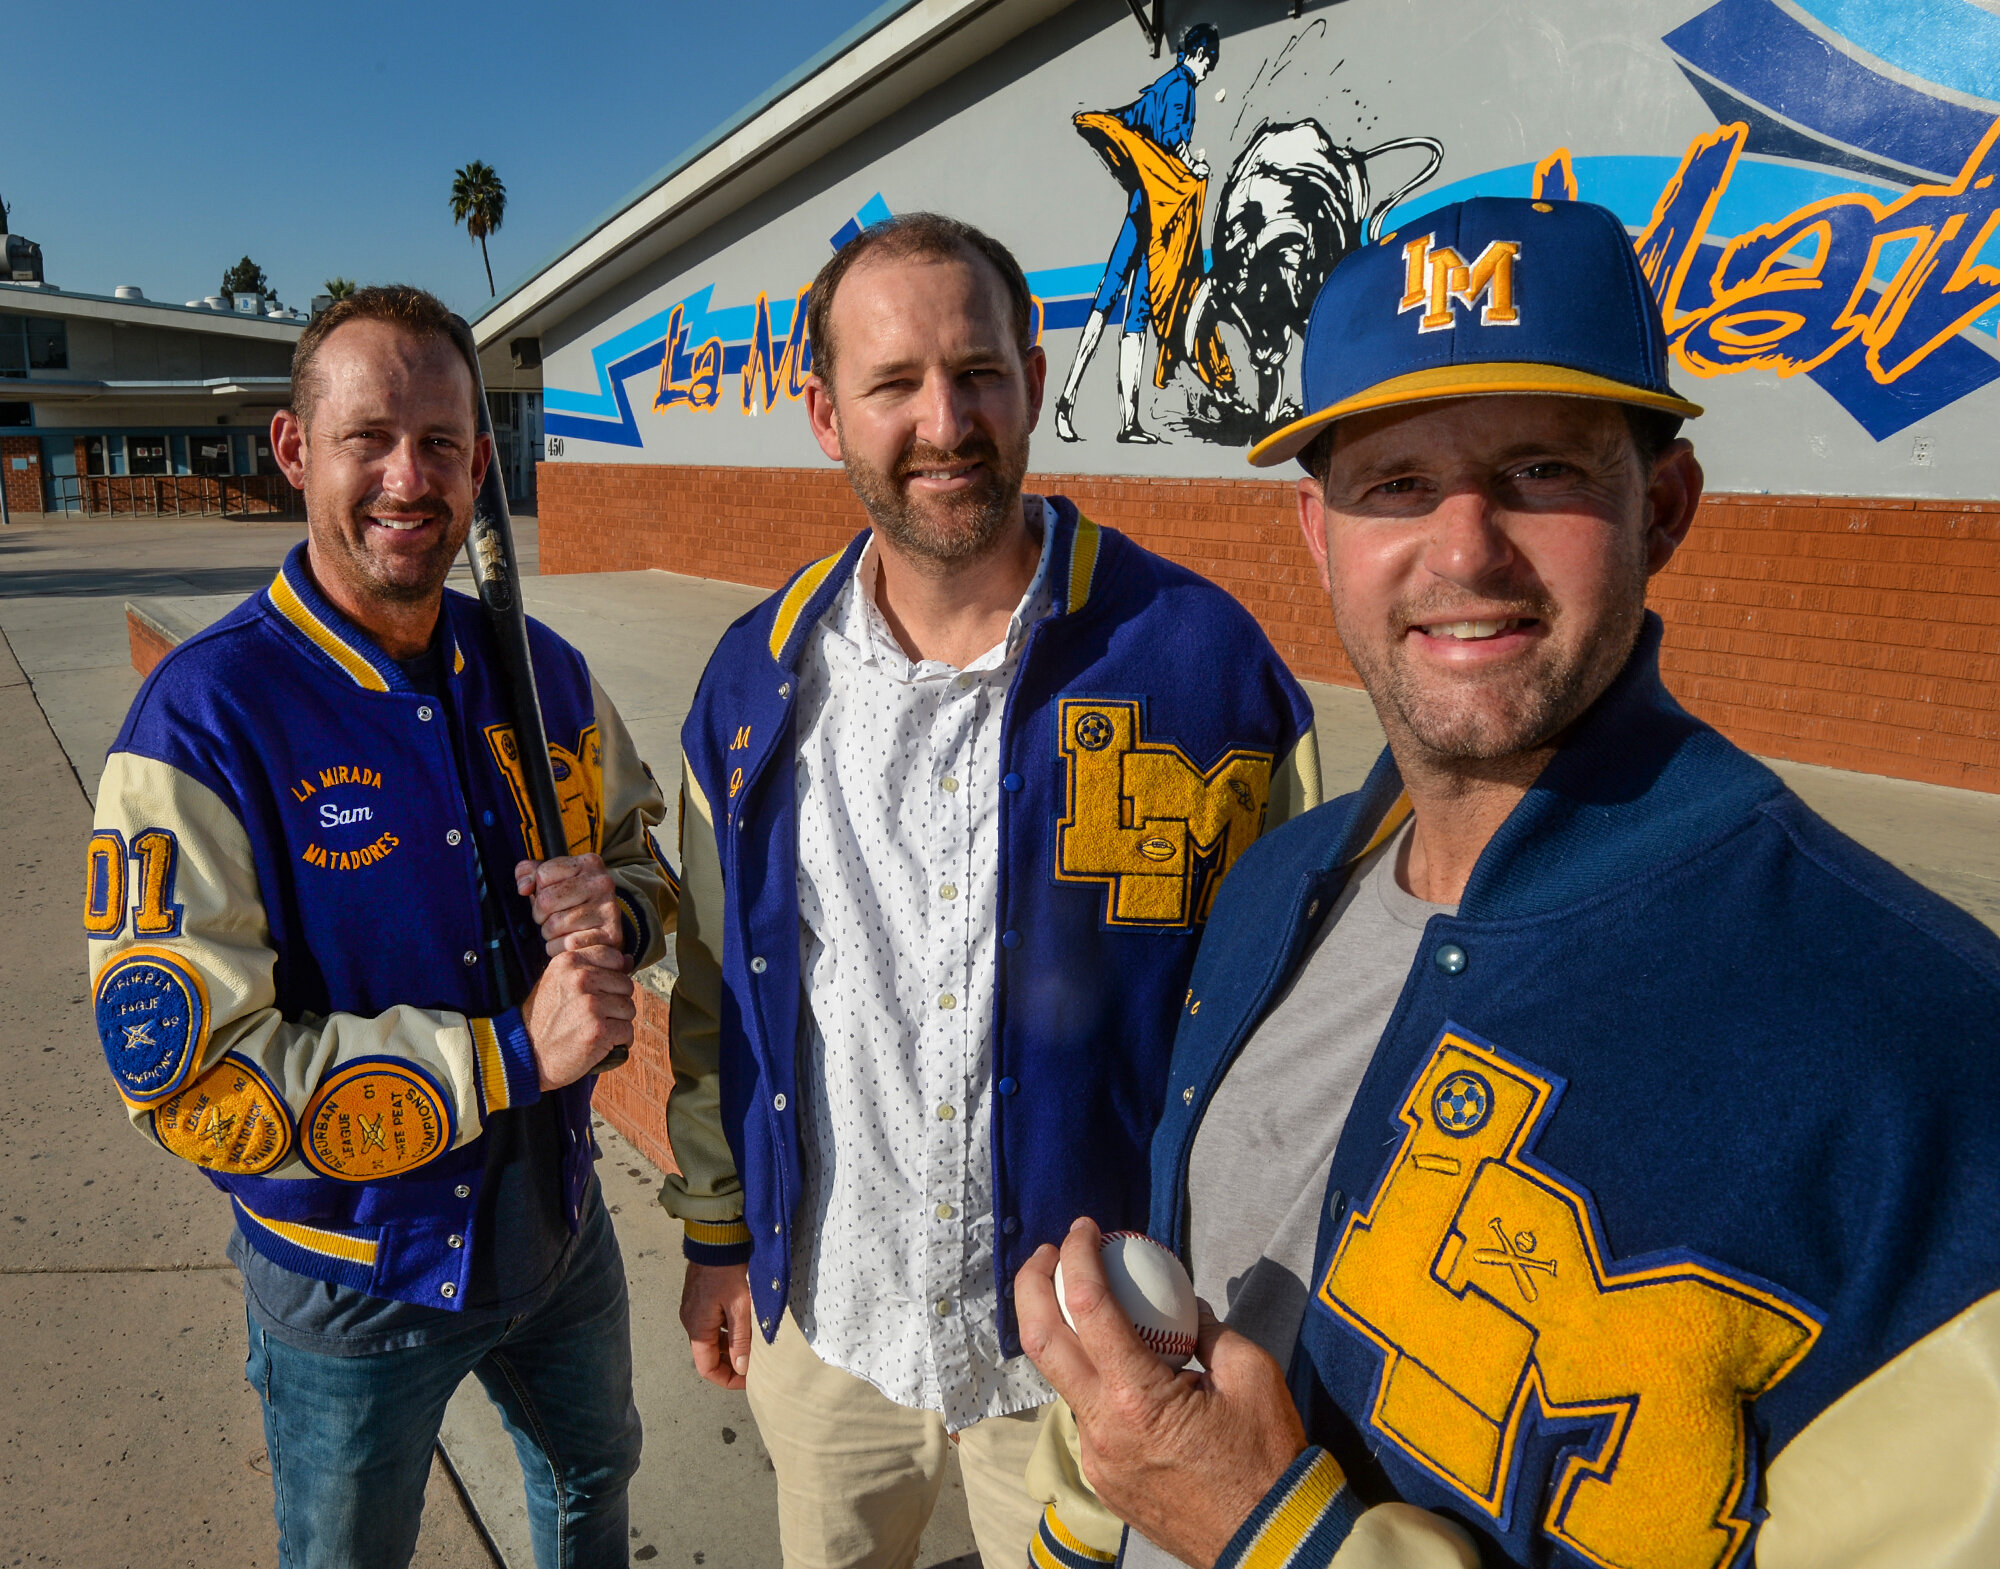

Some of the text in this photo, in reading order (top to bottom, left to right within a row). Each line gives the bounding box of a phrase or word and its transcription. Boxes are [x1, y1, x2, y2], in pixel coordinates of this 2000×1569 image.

[1398, 231, 1522, 334] LM
[652, 303, 725, 416] La
[547, 437, 564, 456] 450
[291, 766, 381, 802] LA MIRADA
[320, 804, 373, 828] Sam
[1055, 697, 1275, 927] LM
[302, 831, 400, 871] MATADORES
[84, 829, 180, 938] 01
[185, 1093, 210, 1132] LEAGUE
[363, 1083, 376, 1100] 01
[391, 1091, 404, 1126] PEAT
[238, 1128, 251, 1140] TO
[314, 1101, 347, 1169] SUBURBAN
[339, 1113, 355, 1159] LEAGUE
[405, 1088, 436, 1158] CHAMPIONS
[1318, 1032, 1823, 1569] LM
